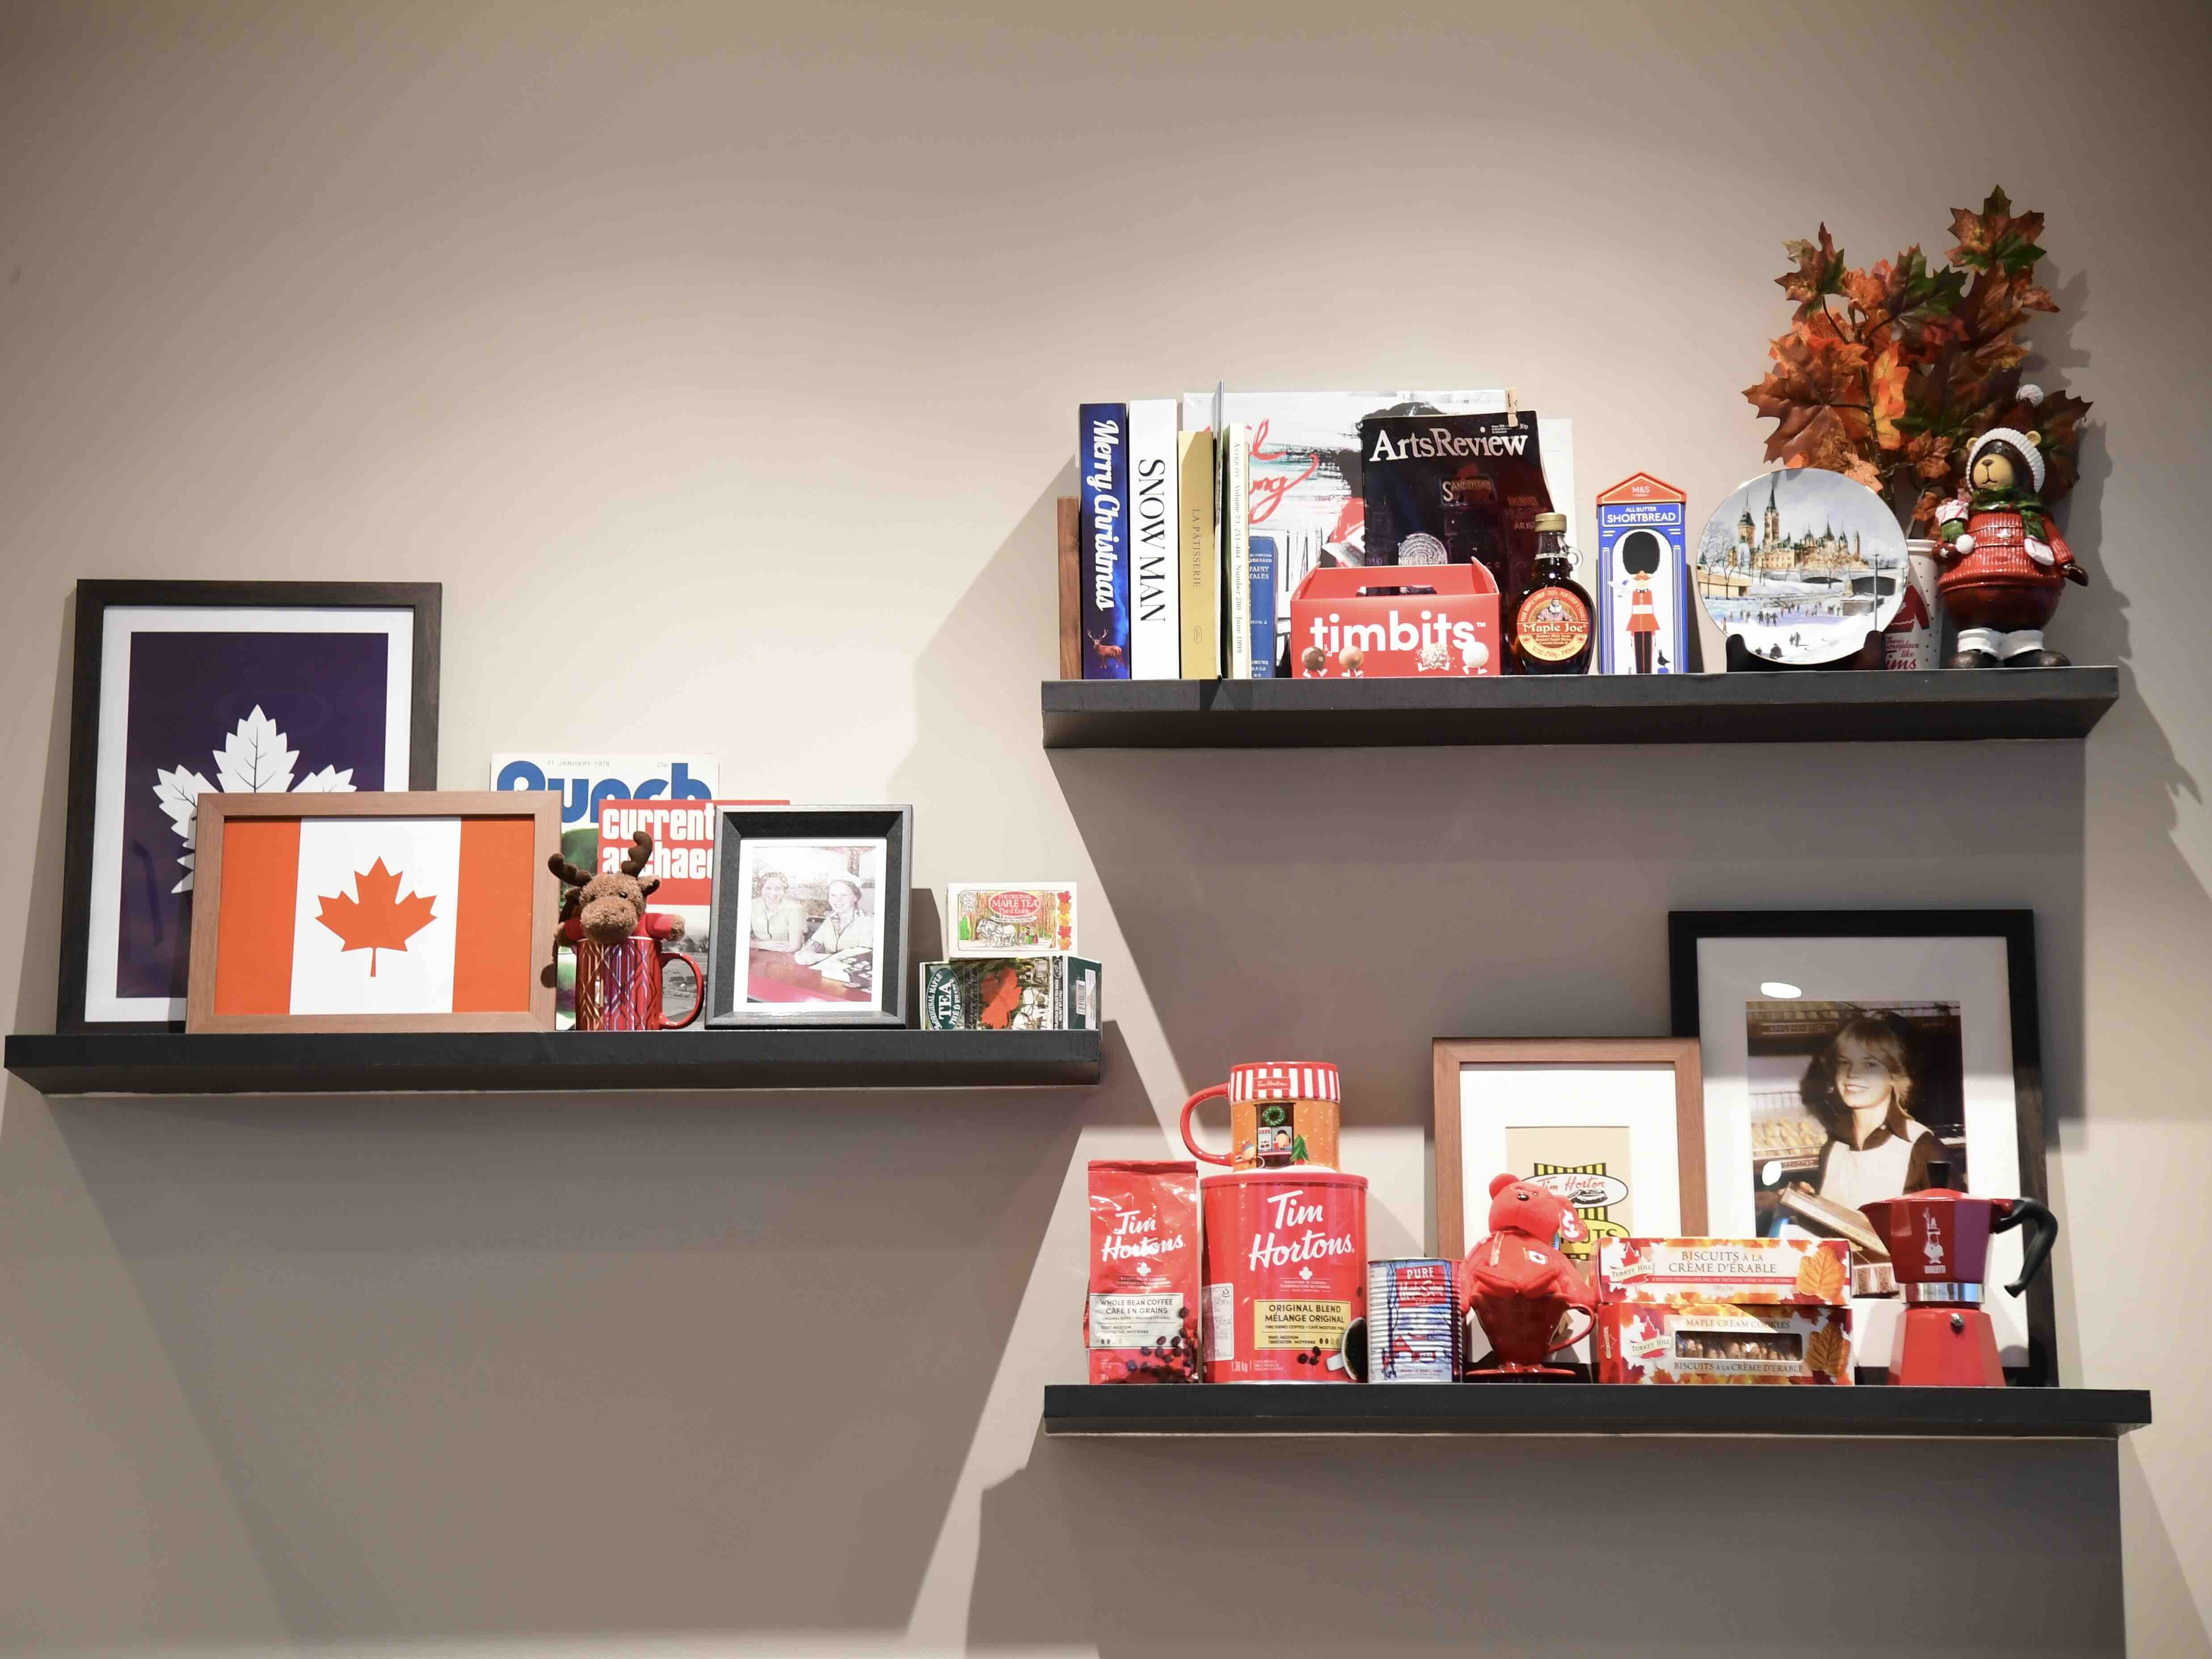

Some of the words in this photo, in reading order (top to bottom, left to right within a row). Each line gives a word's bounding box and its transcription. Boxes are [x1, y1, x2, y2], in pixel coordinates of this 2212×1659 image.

[1087, 420, 1119, 491] Merry
[1631, 485, 1650, 494] M&S
[1138, 459, 1166, 550] SNOW
[1192, 509, 1200, 522] LA
[1607, 512, 1676, 523] SHORTBREAD
[1094, 492, 1120, 611] Christmas
[1139, 556, 1166, 622] MAN
[1522, 623, 1561, 634] Maple
[1565, 623, 1584, 632] Joe
[1887, 658, 1917, 670] ims
[603, 802, 715, 841] current
[991, 899, 1019, 908] MAPLE
[1020, 899, 1038, 908] TEA
[929, 973, 943, 994] MAPLE
[939, 982, 952, 1019] TEA
[927, 994, 939, 1023] ORIGINAL
[1536, 1176, 1559, 1191] Tim
[1564, 1176, 1607, 1192] Horton
[1267, 1190, 1323, 1230] Tim
[1113, 1209, 1157, 1235] Tim
[1101, 1234, 1185, 1263] Hortons
[1248, 1230, 1352, 1272] Hortons
[1681, 1251, 1740, 1262] BISCUITS
[1750, 1253, 1763, 1261] LA
[1612, 1268, 1635, 1278] TURKEY
[1638, 1264, 1652, 1272] HILL
[1668, 1259, 1715, 1273] CRÈME
[1717, 1259, 1777, 1273] D'ÉRABLE
[1406, 1267, 1434, 1280] PURE
[1269, 1304, 1313, 1312] ORIGINAL
[1315, 1305, 1341, 1313] BLEND
[1264, 1312, 1307, 1322] MÉLANGE
[1309, 1314, 1345, 1323] ORIGINAL
[1686, 1318, 1715, 1327] MAPLE
[1717, 1319, 1749, 1328] CREAM
[1750, 1320, 1791, 1329] COOKIES
[1631, 1342, 1654, 1352] TURKEY
[1674, 1362, 1714, 1370] BISCUITS
